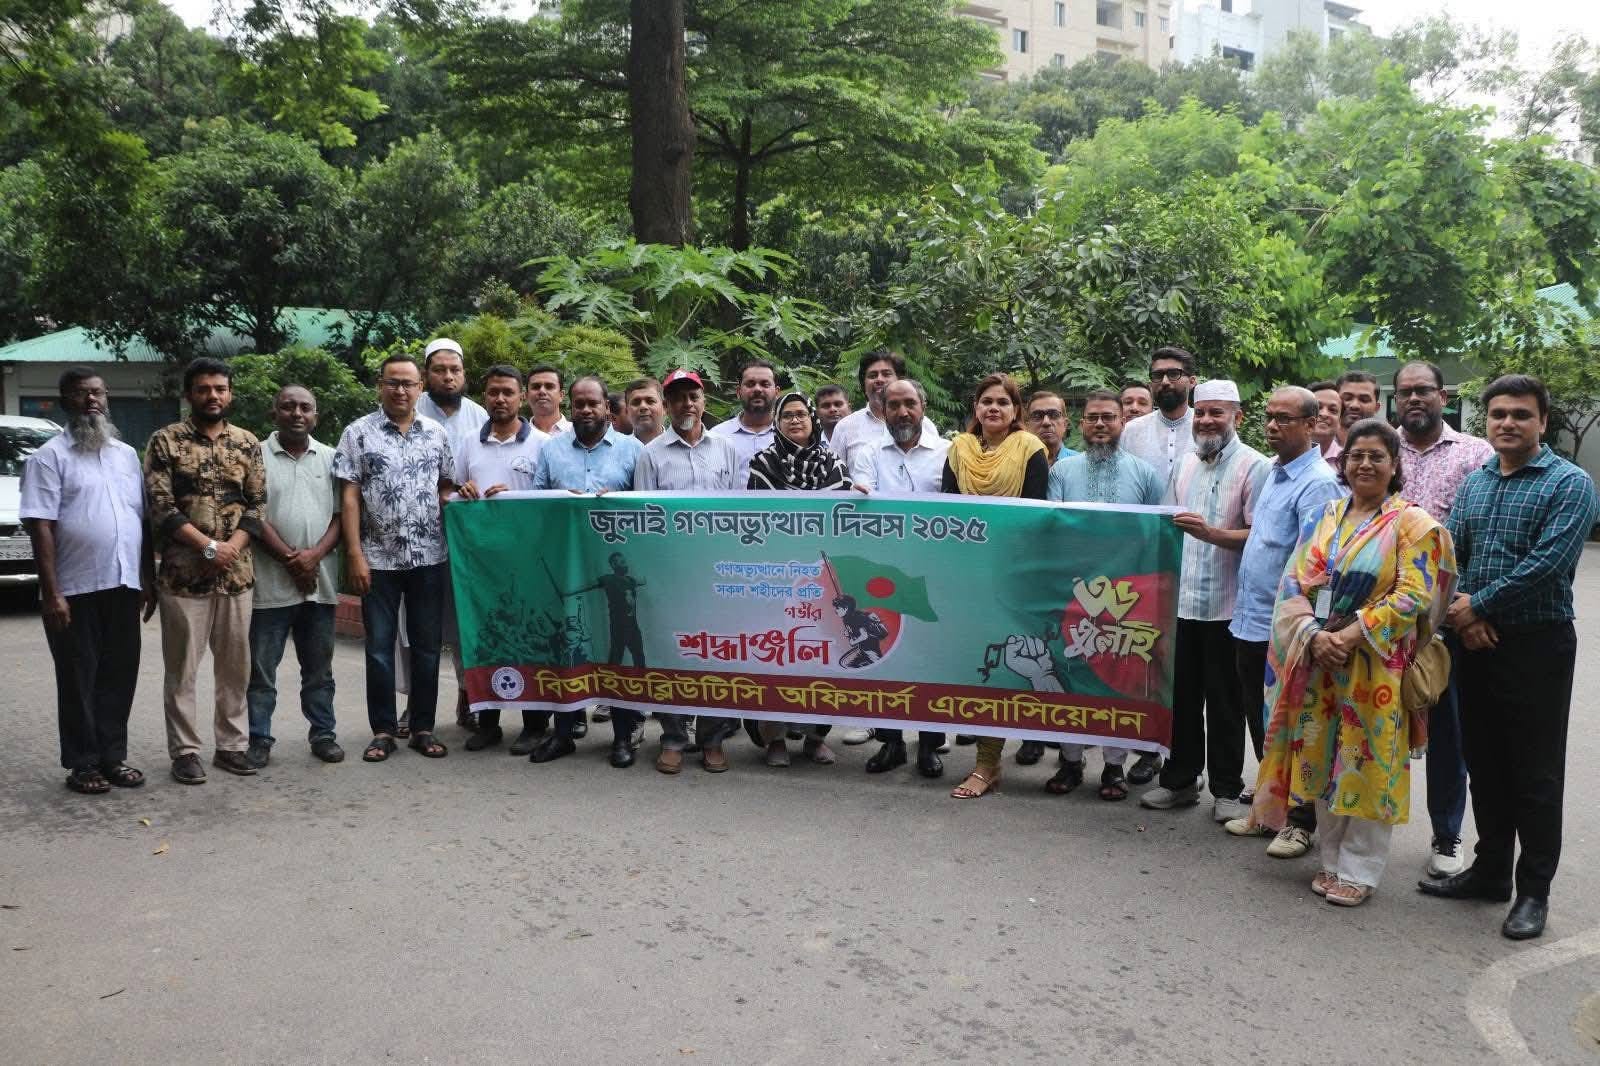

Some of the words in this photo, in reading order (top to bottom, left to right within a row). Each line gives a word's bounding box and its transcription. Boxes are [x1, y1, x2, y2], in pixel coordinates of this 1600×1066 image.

[588, 503, 668, 545] জুলাই
[832, 502, 904, 539] দিবস
[912, 514, 988, 543] ২০২৫
[789, 561, 822, 577] নিহত
[715, 583, 745, 596] সকল
[749, 581, 793, 598] শহীদের
[797, 584, 823, 599] প্রতি
[784, 602, 822, 621] গভীর
[676, 625, 833, 666] শ্রদ্ধাঞ্জলি
[1064, 617, 1159, 662] জুলাই
[534, 668, 767, 705] বিআইডব্লিউটিসি
[775, 680, 918, 715] অফিসার্স
[928, 693, 1149, 736] এসোসিয়েশন
